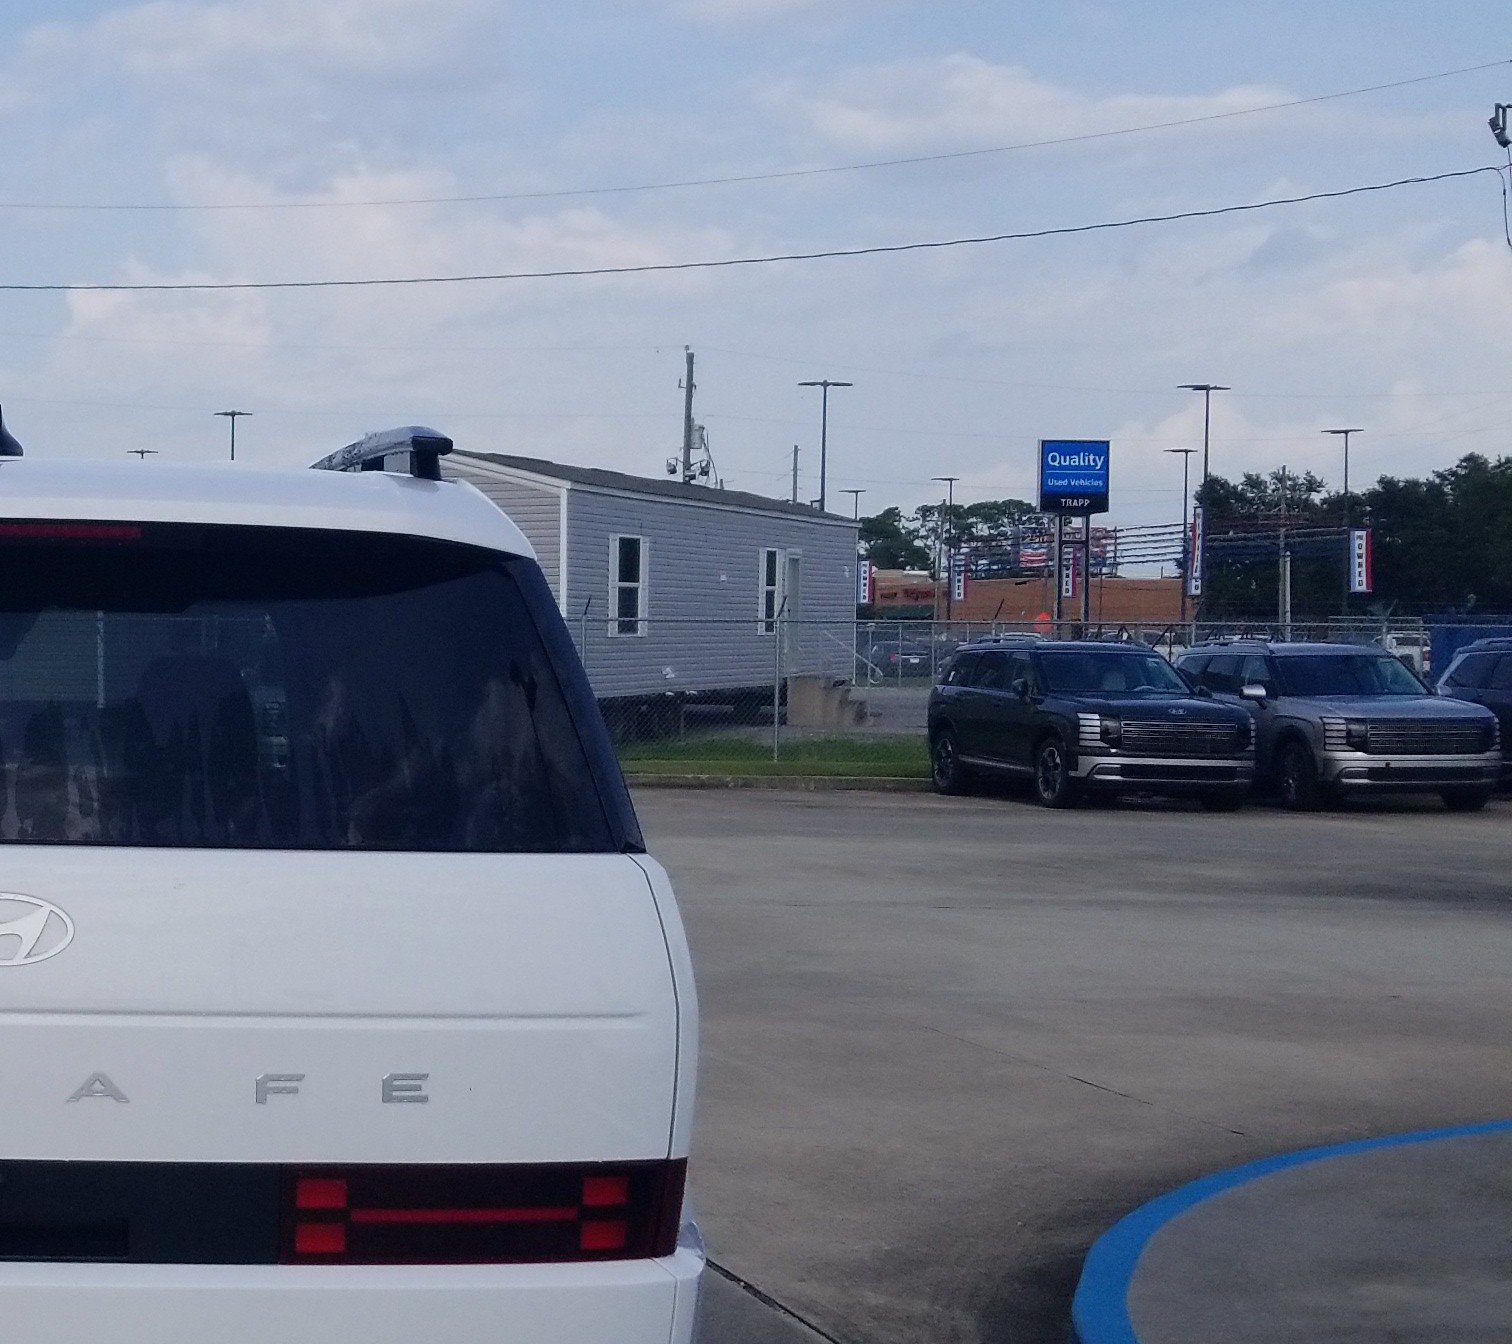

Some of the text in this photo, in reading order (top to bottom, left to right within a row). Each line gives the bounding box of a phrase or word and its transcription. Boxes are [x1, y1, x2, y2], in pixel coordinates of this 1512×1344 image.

[1047, 452, 1105, 470] Quality
[1048, 478, 1103, 487] Used Vehicles
[1060, 498, 1091, 507] TRAPP
[255, 1072, 430, 1105] FE
